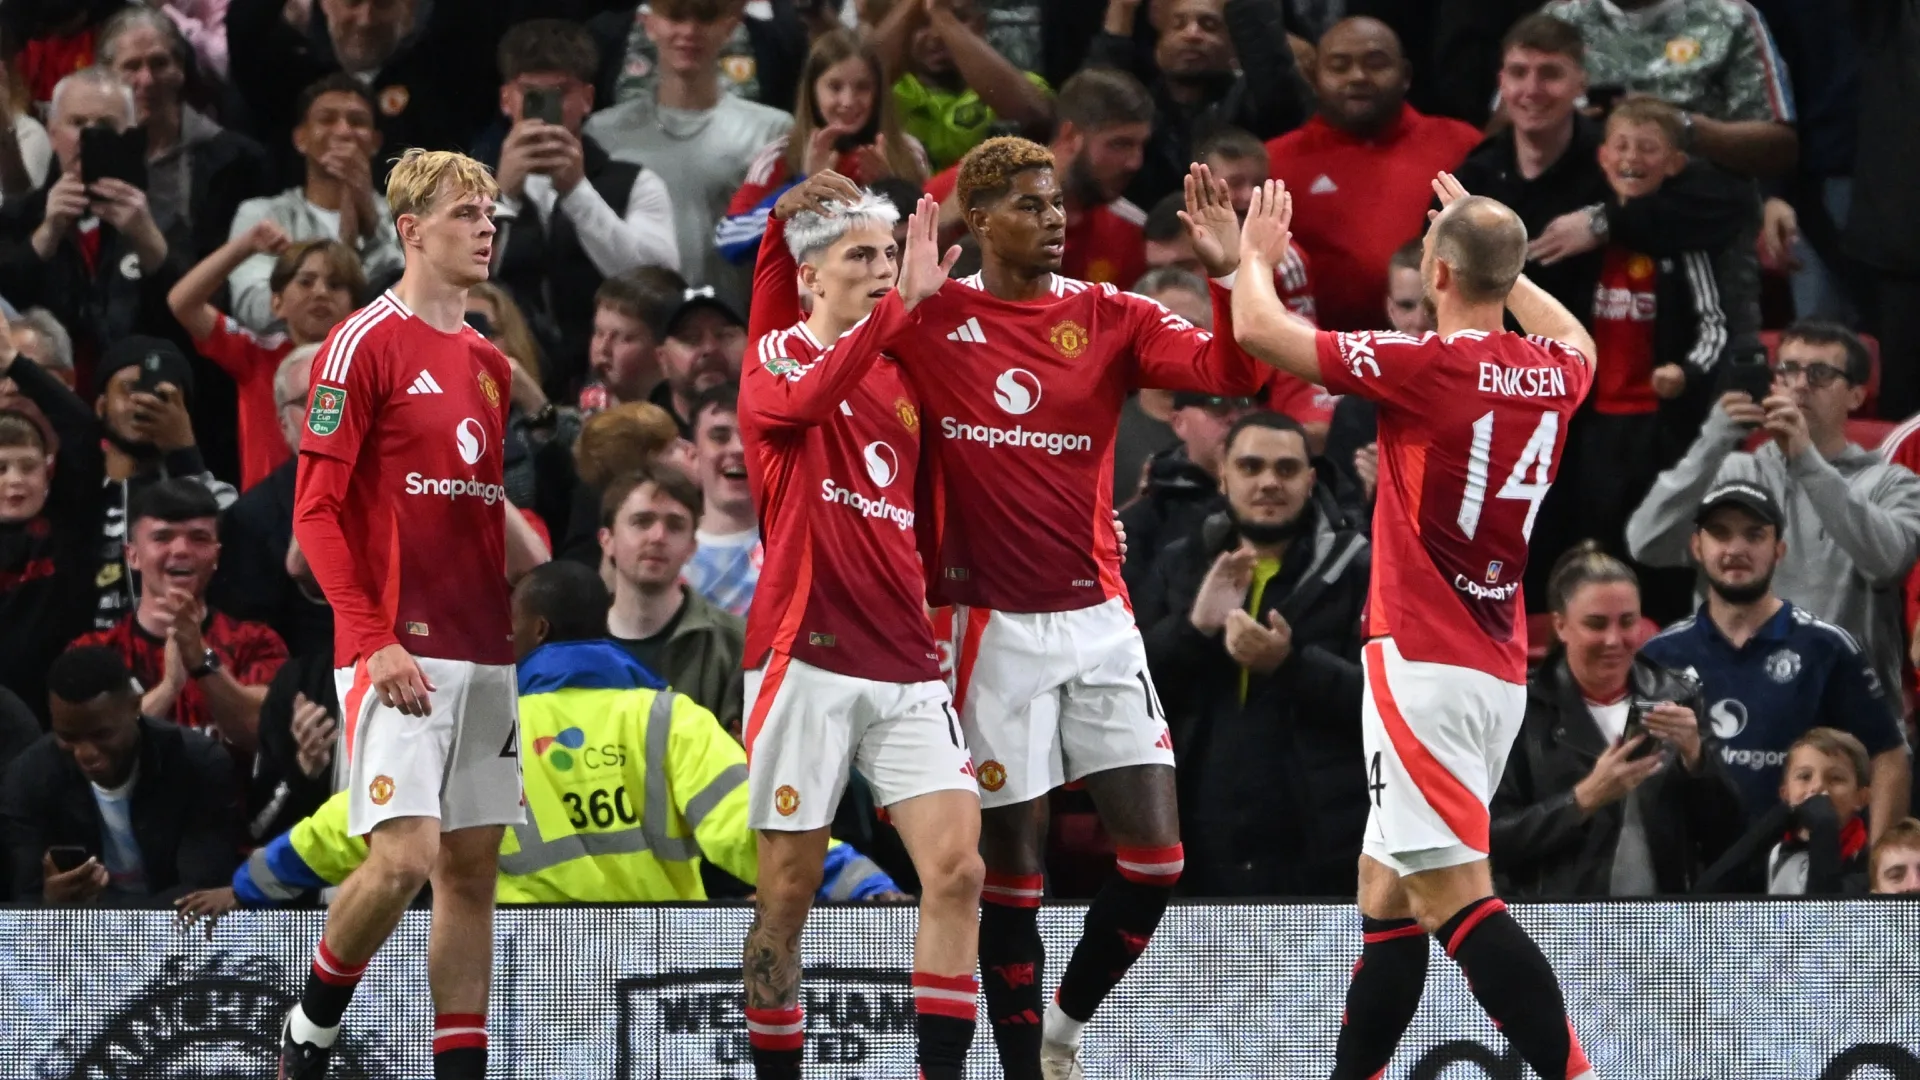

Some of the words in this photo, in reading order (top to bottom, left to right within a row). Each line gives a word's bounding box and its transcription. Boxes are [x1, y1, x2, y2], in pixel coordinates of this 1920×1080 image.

[1478, 361, 1567, 398] ERIKSEN
[940, 416, 1092, 455] Snapdragon
[405, 471, 505, 506] Snapdrago
[1457, 410, 1559, 545] 14
[499, 719, 523, 776] 4
[1365, 751, 1387, 809] 4
[562, 785, 639, 829] 360
